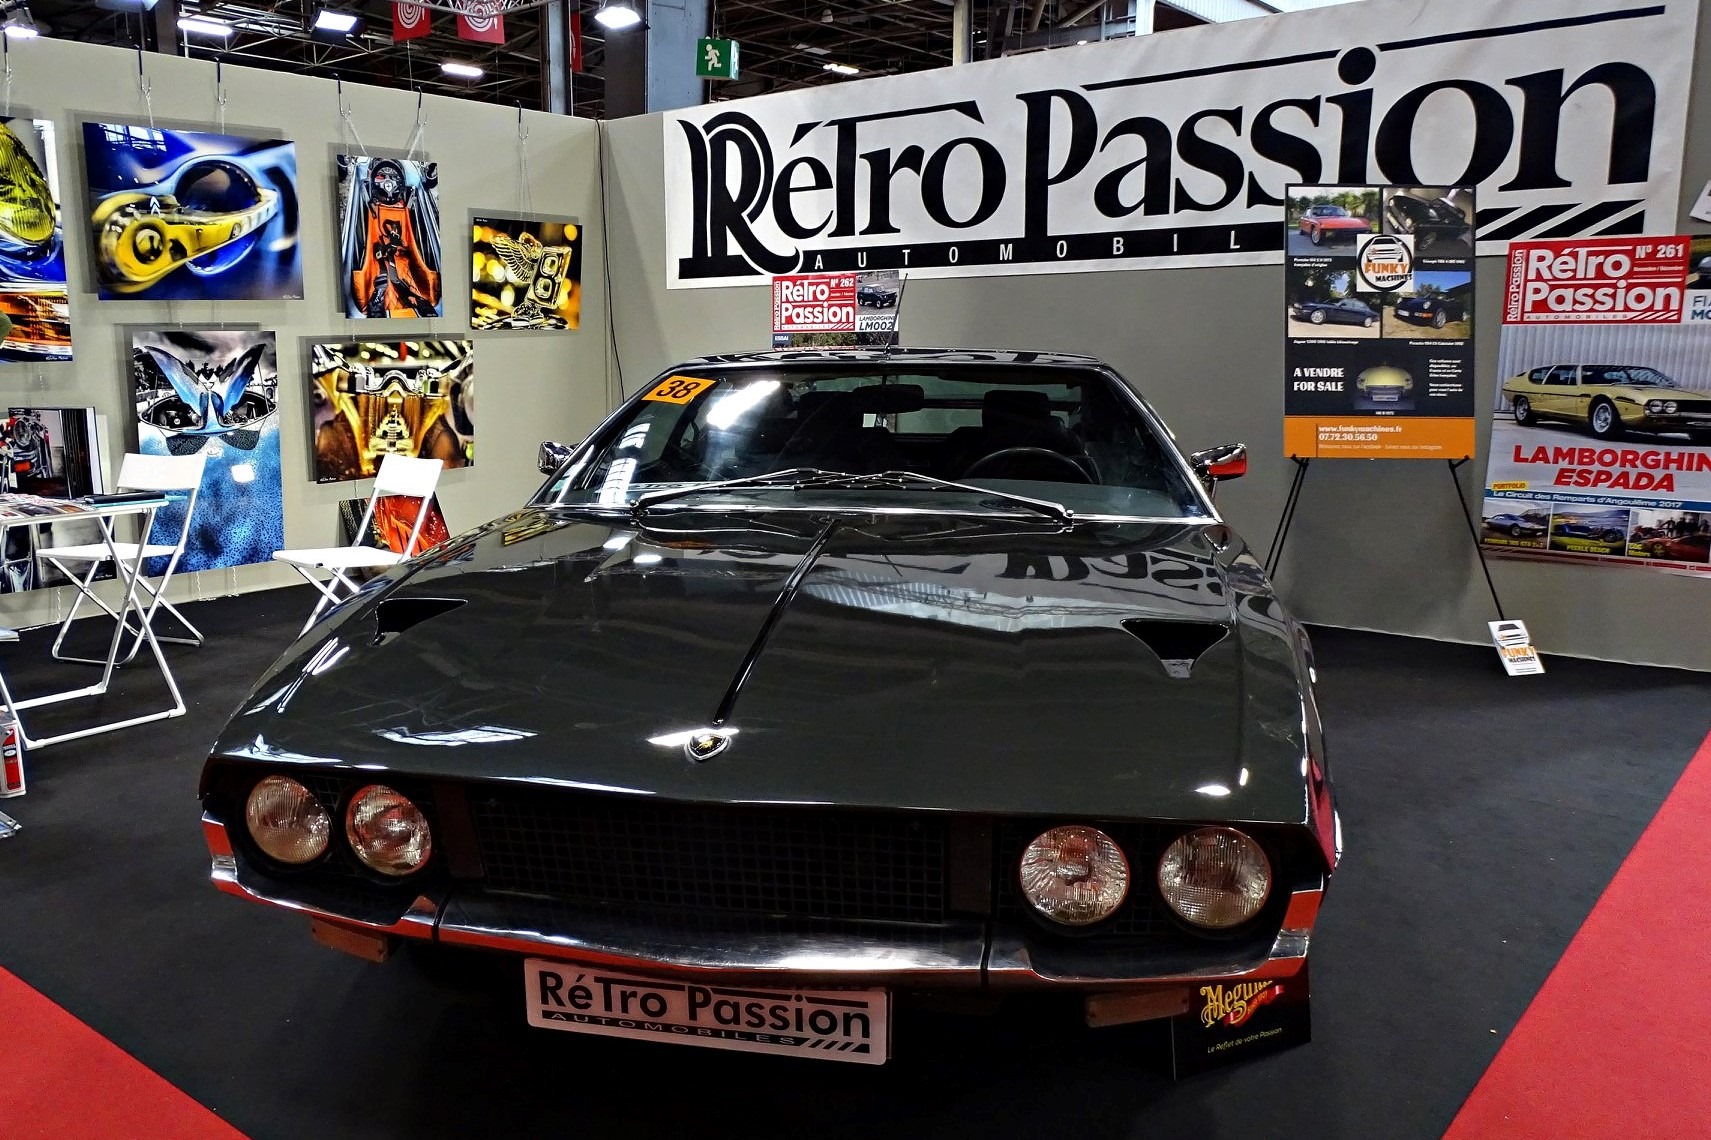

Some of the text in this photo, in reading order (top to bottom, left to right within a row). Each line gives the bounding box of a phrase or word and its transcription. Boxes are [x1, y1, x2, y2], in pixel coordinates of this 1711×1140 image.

[1016, 46, 1657, 238] Passion
[813, 231, 1241, 268] AUTOMOBIL
[1656, 244, 1684, 258] 261
[1364, 262, 1409, 274] FUNKY
[1510, 250, 1524, 292] Passion
[840, 278, 854, 287] 262
[1375, 274, 1412, 283] MACHINES
[1525, 279, 1681, 312] Passion
[781, 301, 854, 323] Passion
[859, 322, 893, 331] LM002
[1293, 367, 1345, 378] A VENDRE
[656, 380, 701, 399] 38
[1294, 381, 1344, 392] FOR SALE
[1318, 425, 1402, 433] www.funkymachines.fr
[1553, 468, 1675, 492] ESPADA
[1505, 491, 1533, 499] Circuit
[1553, 495, 1595, 504] Remparts
[688, 985, 871, 1039] Passion
[551, 1012, 797, 1046] AUTOMOBILES
[1260, 1028, 1282, 1037] Passion
